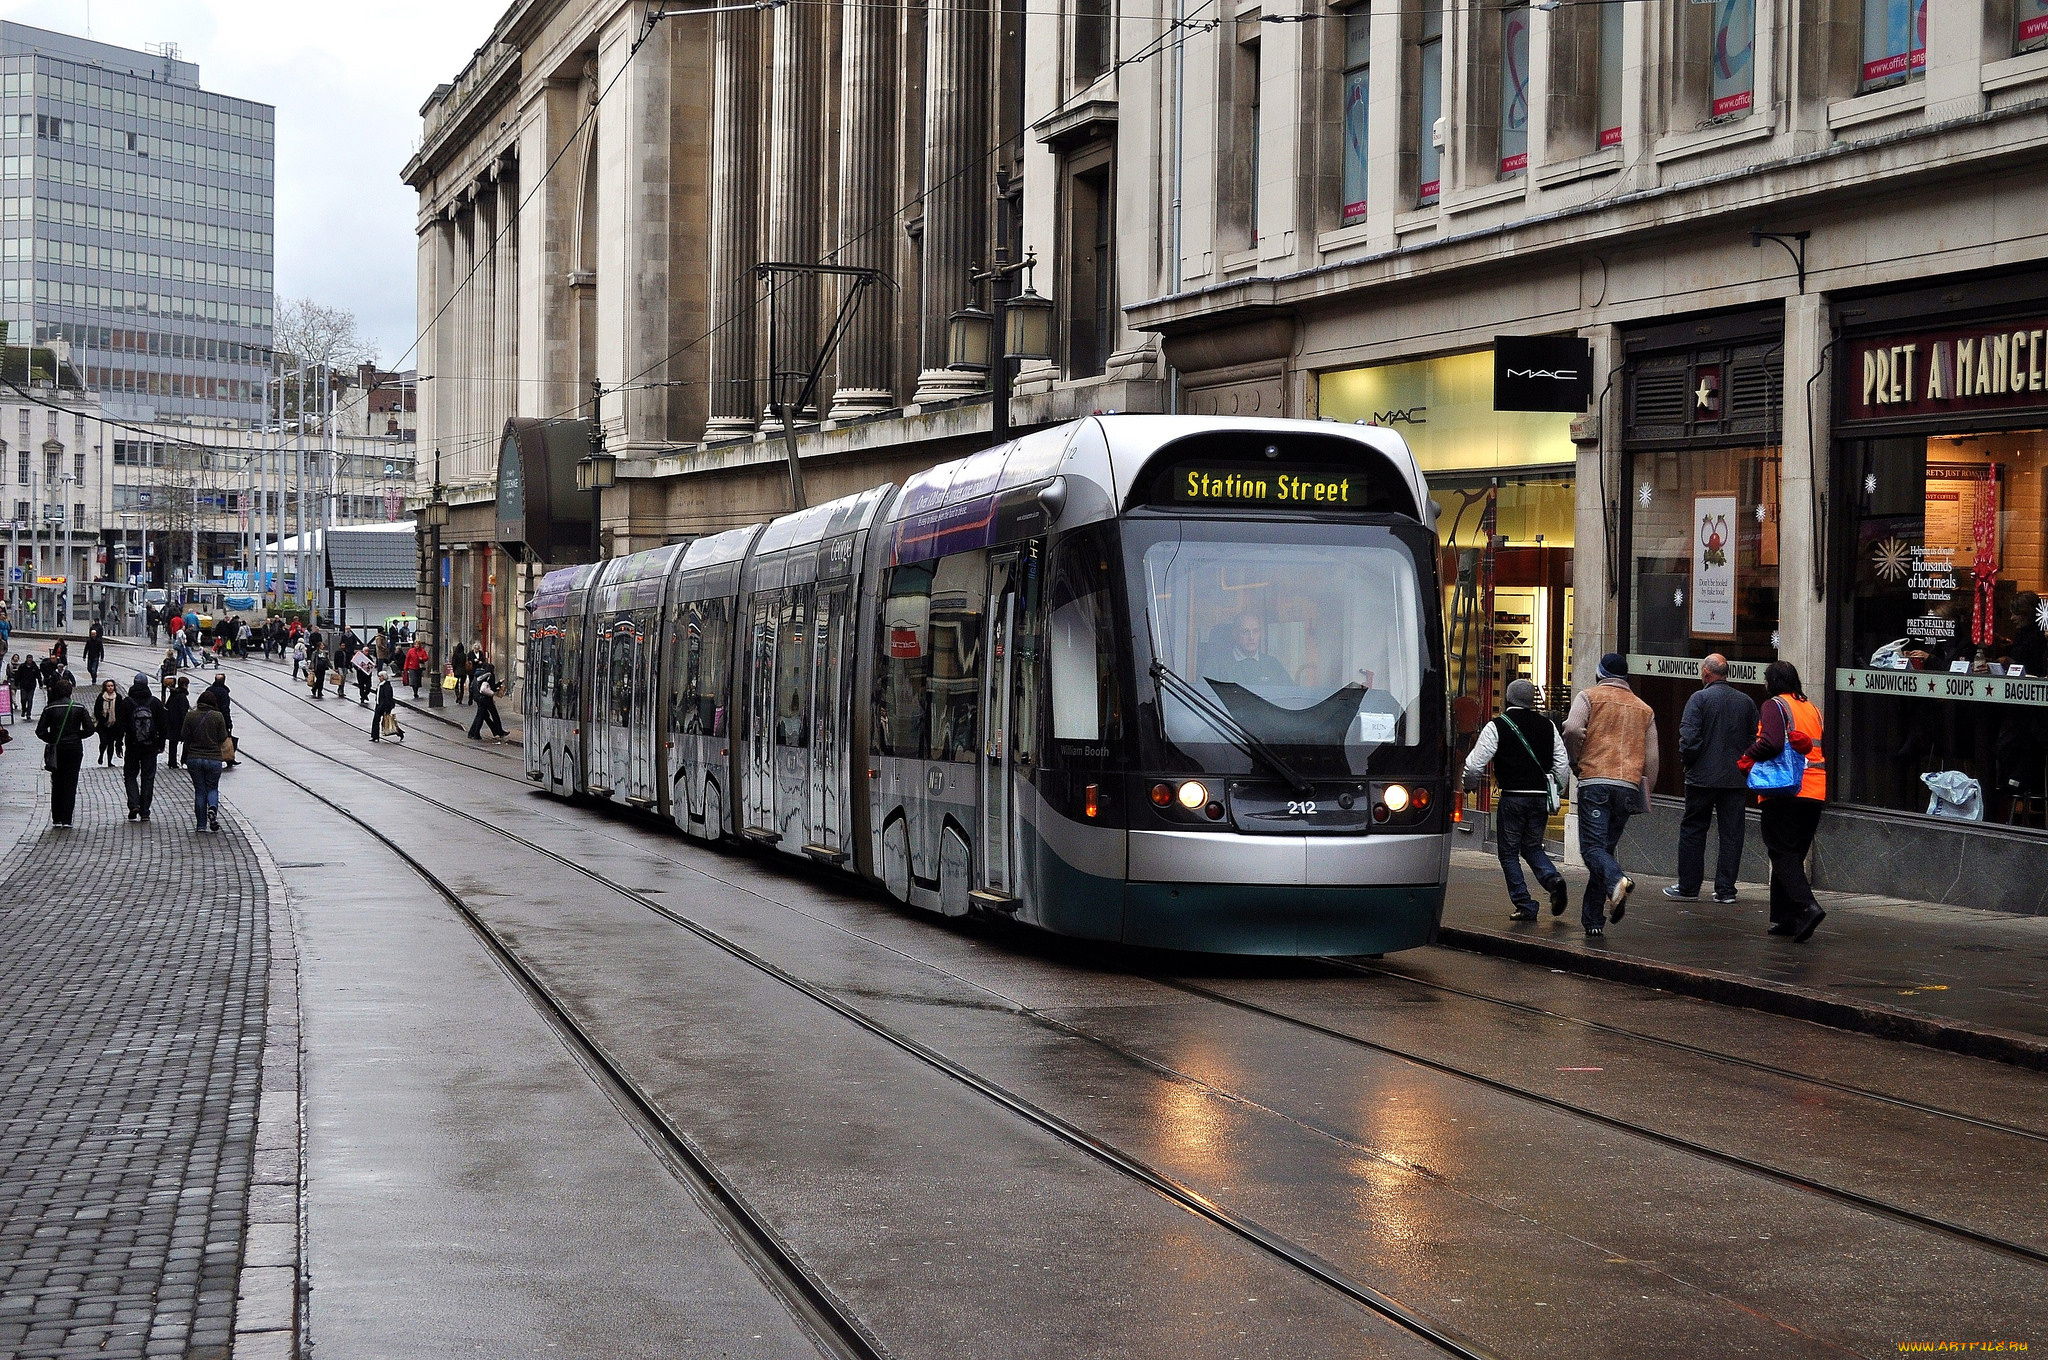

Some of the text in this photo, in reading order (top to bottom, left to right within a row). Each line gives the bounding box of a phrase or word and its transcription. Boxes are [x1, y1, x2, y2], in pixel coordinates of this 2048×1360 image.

[1863, 330, 2048, 405] PRET A MANGE
[1926, 469, 1944, 478] RET'S
[1187, 471, 1349, 502] Station Street
[830, 539, 852, 567] George
[1912, 557, 1952, 571] thousands
[1908, 573, 1956, 589] of hot meals
[1918, 590, 1927, 600] the
[1927, 590, 1951, 600] homeless
[1925, 619, 1945, 628] REALLY
[1945, 620, 1955, 629] BIG
[1907, 627, 1955, 637] CHRISTMAS DINNER
[1657, 660, 1757, 680] SANDWICHES NDMADE
[1865, 674, 1917, 692] SANDWICHES
[1946, 678, 1974, 697] SOUPS
[1084, 745, 1110, 757] Booth
[1287, 800, 1318, 814] 212
